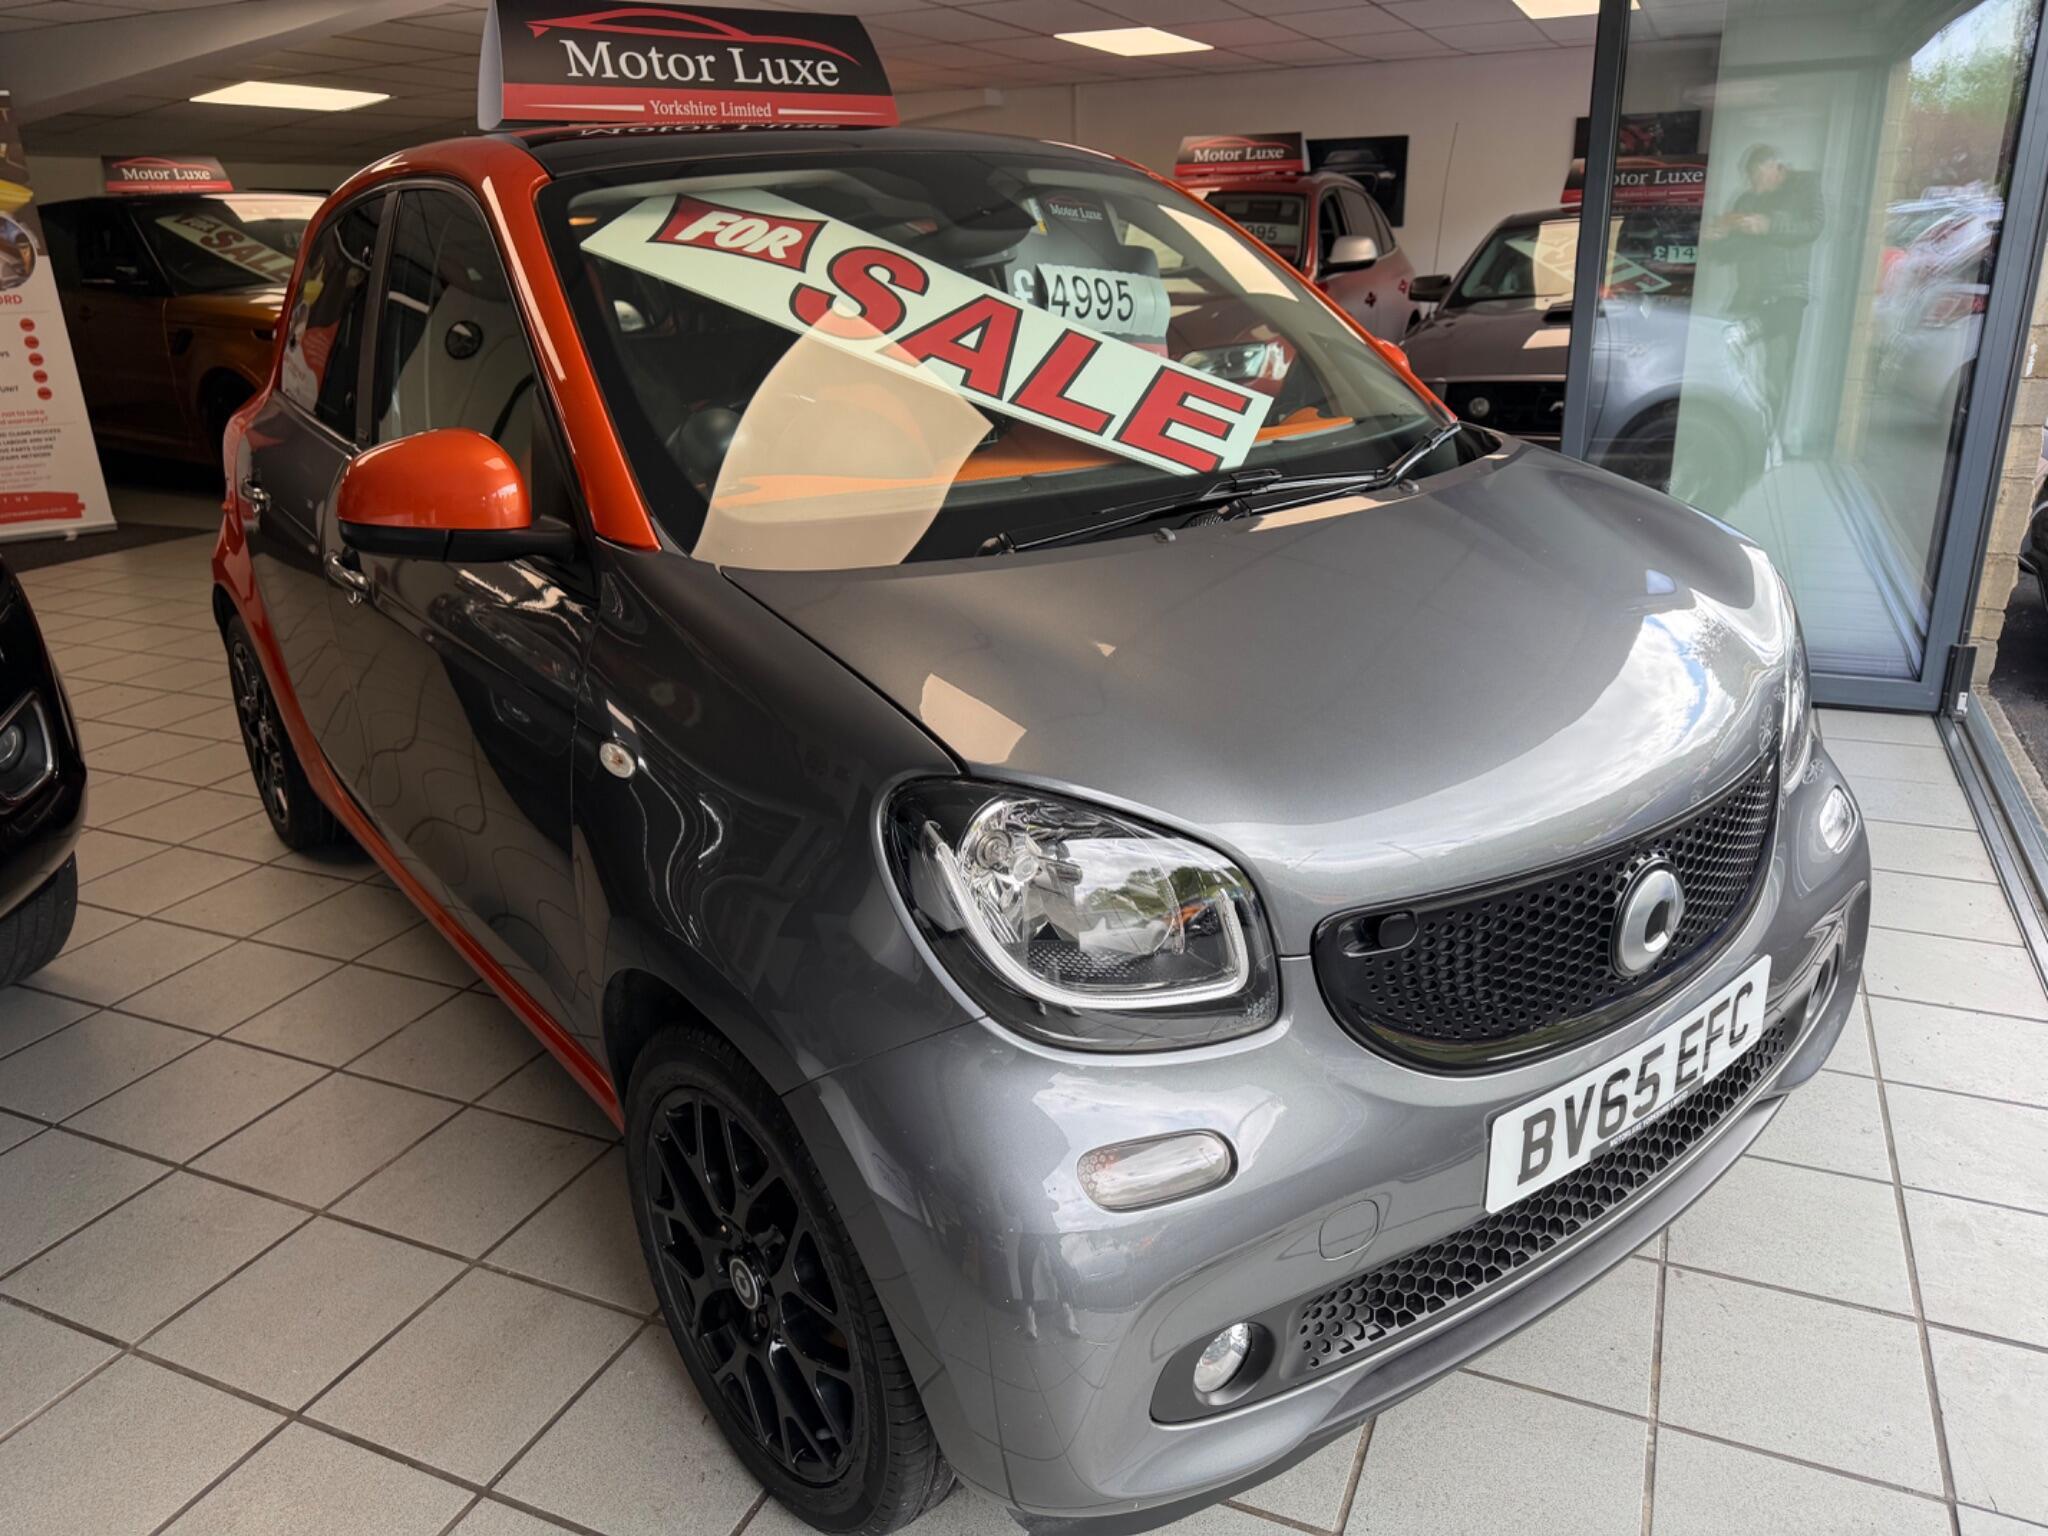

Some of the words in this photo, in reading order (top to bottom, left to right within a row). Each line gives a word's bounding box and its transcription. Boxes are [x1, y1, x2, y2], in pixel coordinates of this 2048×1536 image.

[559, 39, 716, 82] Motor
[727, 47, 840, 87] Luxe
[650, 100, 718, 117] Yorkshire
[720, 102, 772, 118] Limited
[122, 168, 170, 181] Motor
[173, 168, 211, 181] Luxe
[1194, 149, 1241, 163] Motor
[1245, 147, 1285, 160] Luxe
[1614, 172, 1648, 186] tor
[1654, 169, 1704, 185] Luxe
[674, 210, 803, 259] FOR
[1050, 274, 1134, 322] 4995
[790, 245, 1253, 474] SALE
[1517, 1041, 1666, 1187] BV65
[1674, 981, 1753, 1093] EFC
